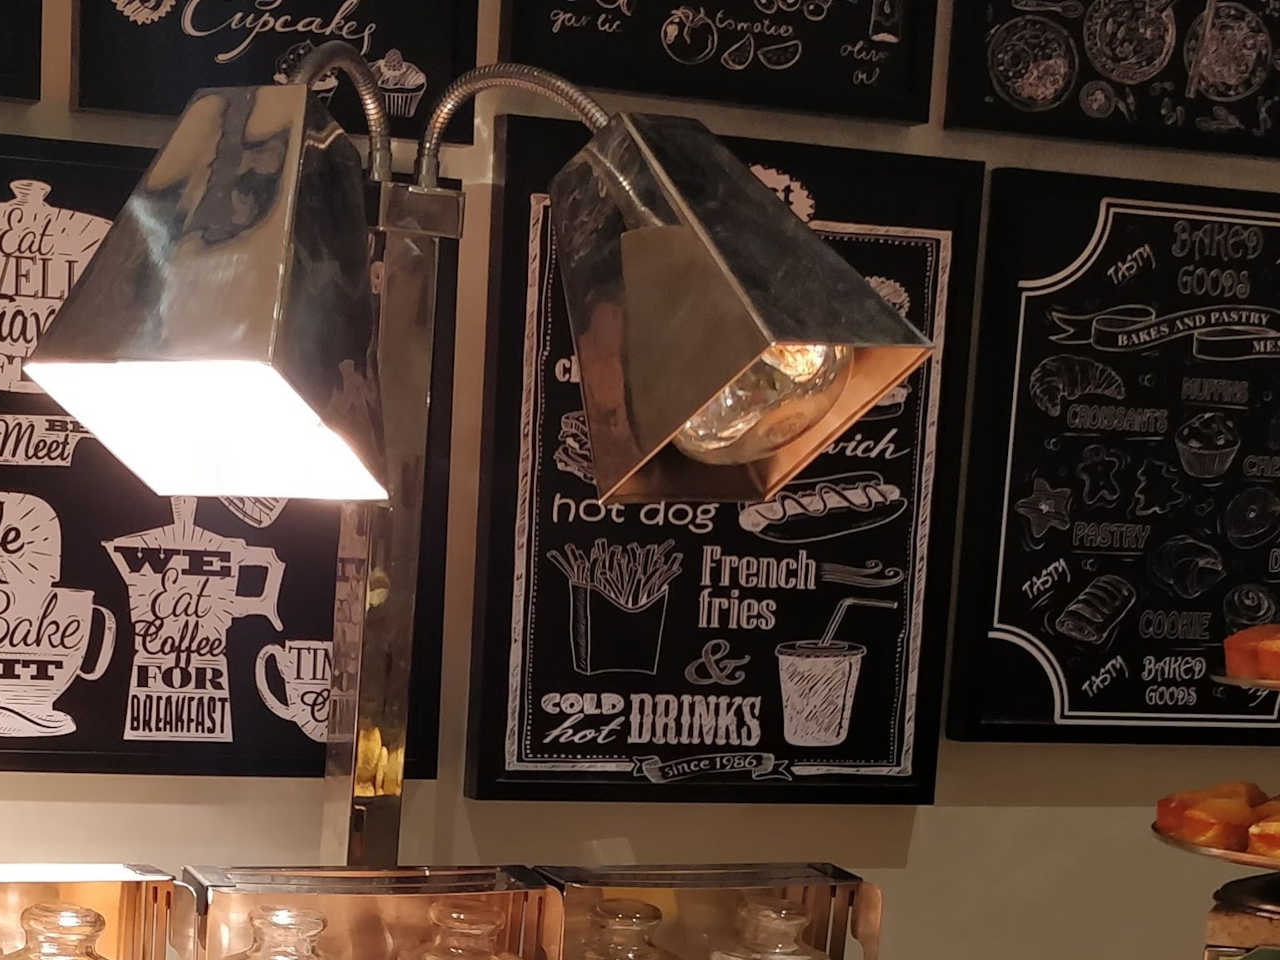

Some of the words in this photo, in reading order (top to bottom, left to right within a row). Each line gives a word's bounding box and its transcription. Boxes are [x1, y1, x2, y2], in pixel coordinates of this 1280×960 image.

[181, 0, 376, 63] Cupcakes
[550, 8, 622, 34] garlic
[1171, 219, 1265, 261] BAKED
[1106, 243, 1157, 286] TASTY
[1177, 264, 1251, 300] GOODS
[1116, 323, 1171, 347] BAKES
[1172, 313, 1206, 335] AND
[1209, 310, 1272, 331] PASTRY
[1066, 402, 1169, 435] CROISSANTS
[10, 417, 91, 462] Meet
[551, 493, 627, 524] hot
[638, 500, 720, 534] dog
[1071, 519, 1151, 550] PASTRY
[113, 545, 233, 577] WE
[699, 544, 817, 590] French
[1019, 556, 1073, 601] TASTY
[151, 569, 212, 619] Eat
[697, 586, 778, 631] fries
[133, 618, 225, 669] Coffee
[1138, 608, 1213, 641] COOKIE
[134, 665, 224, 690] FOR
[684, 638, 751, 686] &
[1080, 653, 1130, 700] TASTY
[1140, 654, 1208, 683] BAKED
[130, 693, 229, 733] BREAKFAST
[540, 692, 626, 715] COLD
[1144, 684, 1199, 707] GOODS
[541, 712, 626, 744] hot
[626, 692, 762, 747] DRINKS
[662, 759, 711, 779] since
[714, 755, 758, 772] 1986
